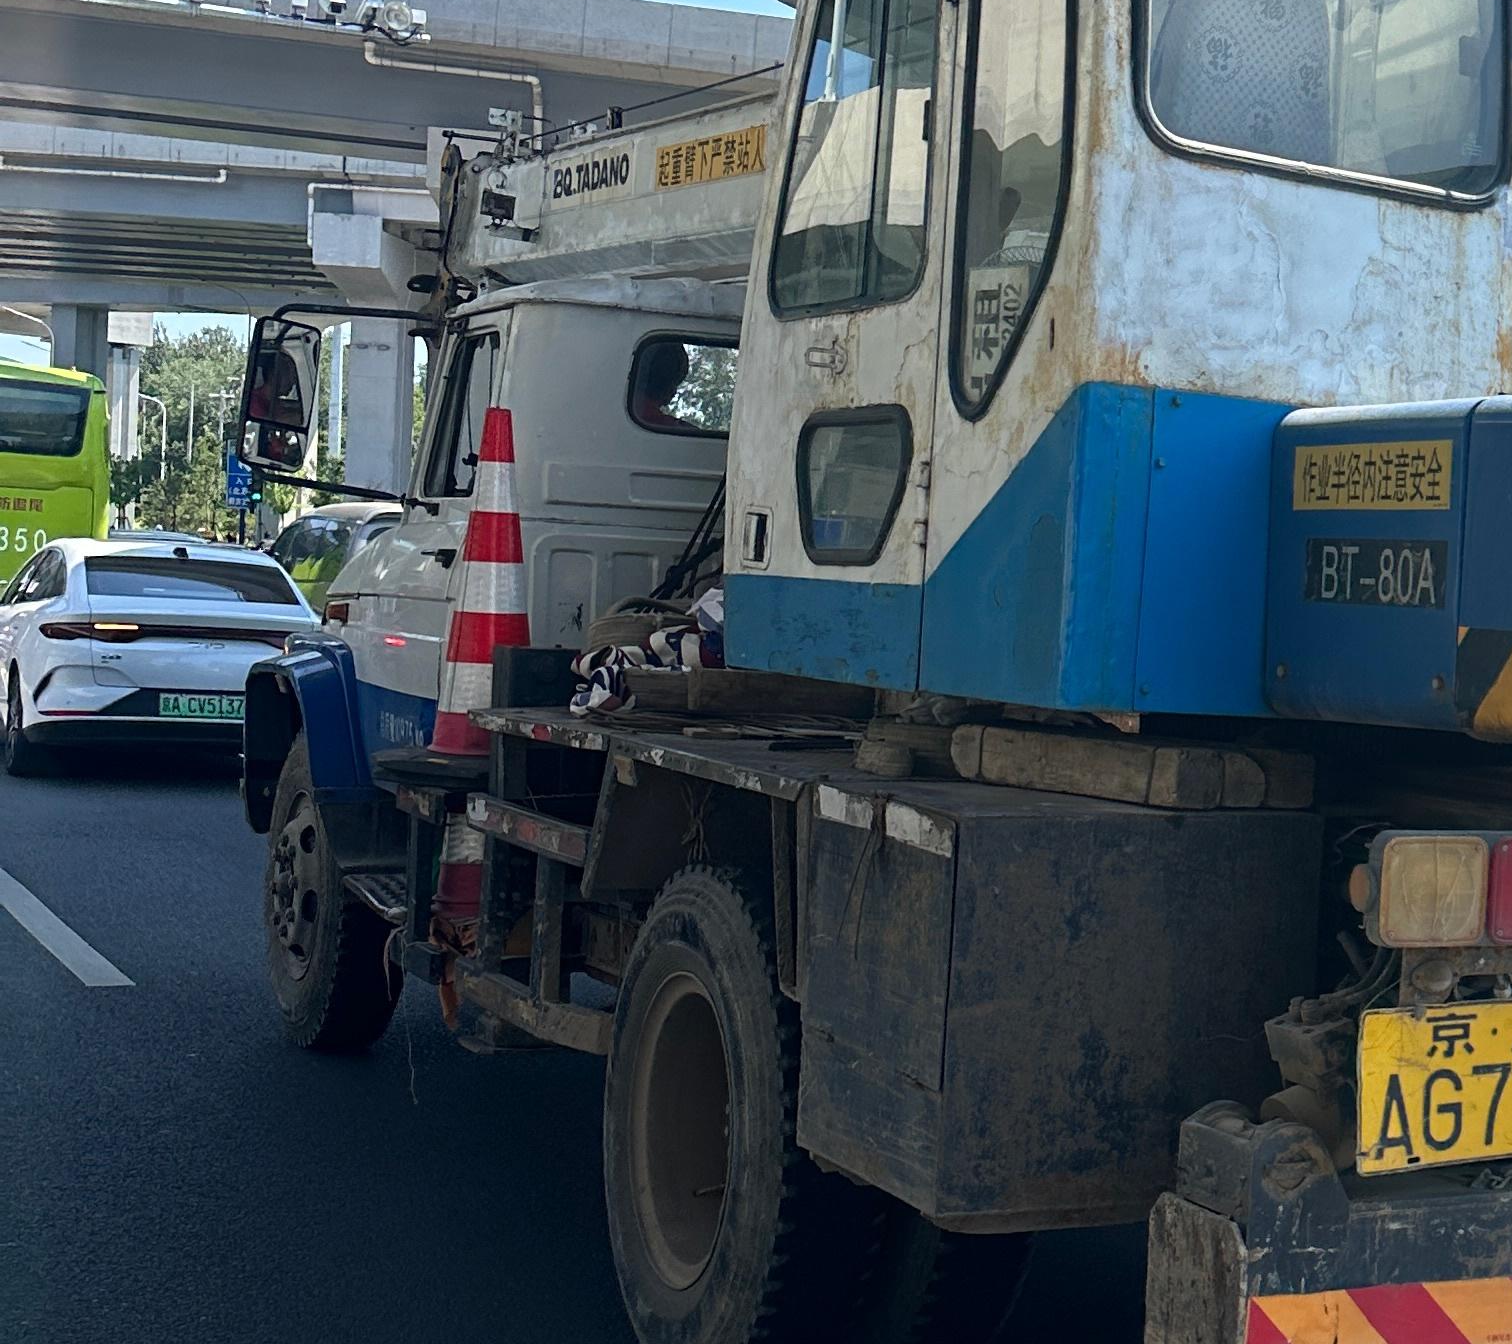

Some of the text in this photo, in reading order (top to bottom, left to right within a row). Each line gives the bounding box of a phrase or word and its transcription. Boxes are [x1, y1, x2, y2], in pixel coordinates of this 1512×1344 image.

[553, 153, 630, 198] BQ.TADANO
[657, 129, 765, 187] 起重臂下严禁站人
[971, 283, 1002, 394] 租
[1303, 447, 1442, 504] 作业半径内注意安全
[1321, 545, 1436, 605] BT-80A
